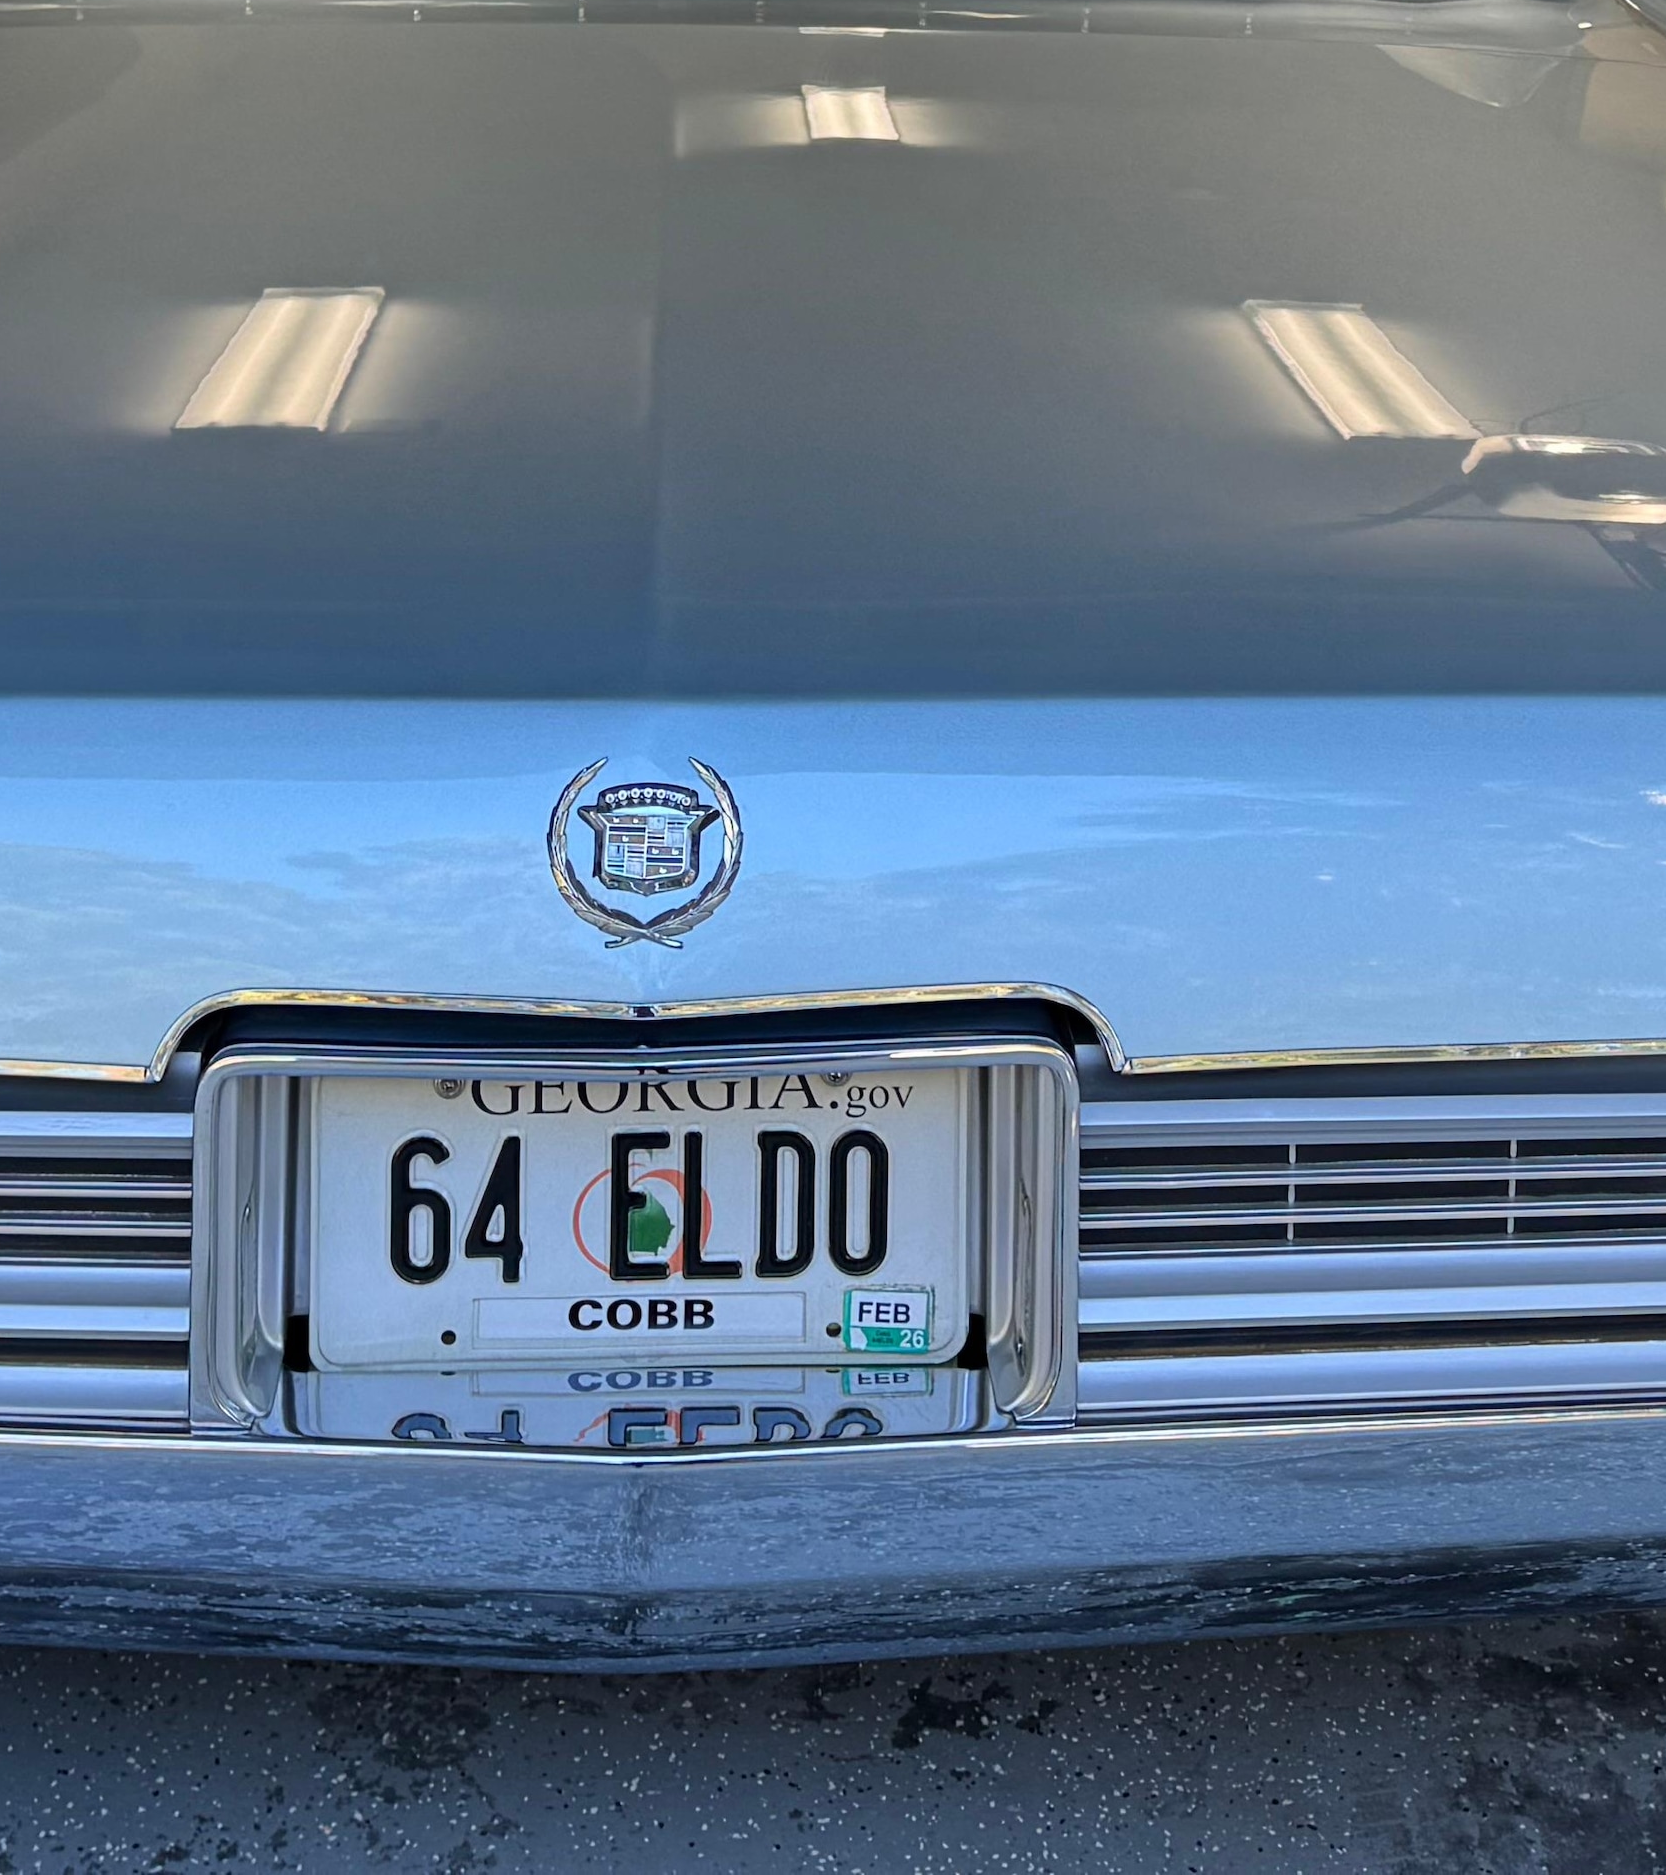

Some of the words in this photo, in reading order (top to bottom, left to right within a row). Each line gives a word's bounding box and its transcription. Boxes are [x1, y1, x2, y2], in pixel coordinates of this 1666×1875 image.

[391, 1136, 523, 1285] 64
[609, 1129, 888, 1280] ELDO
[568, 1299, 714, 1331] COBB
[858, 1302, 910, 1323] FEB
[899, 1329, 924, 1348] 26
